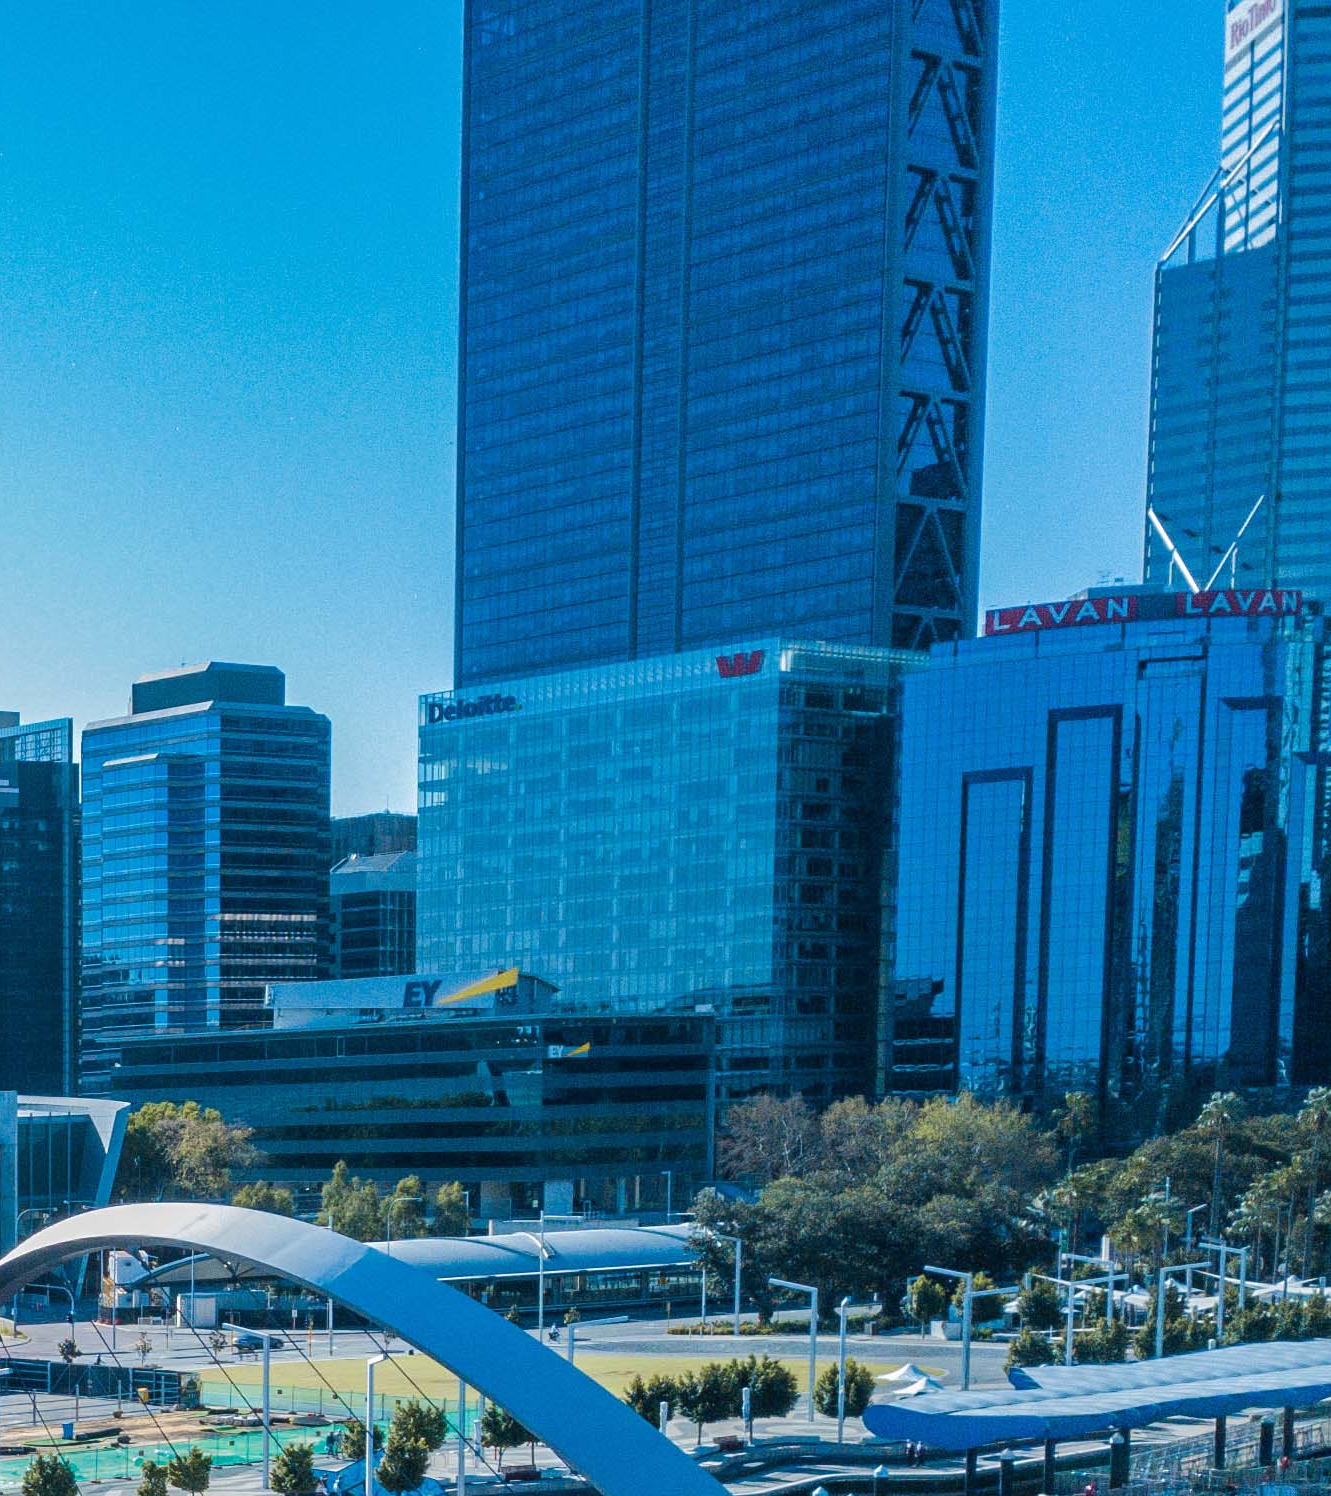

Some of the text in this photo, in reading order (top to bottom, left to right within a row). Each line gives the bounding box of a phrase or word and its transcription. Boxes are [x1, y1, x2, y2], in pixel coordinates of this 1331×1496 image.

[994, 598, 1129, 631] LAVAN
[1185, 591, 1298, 614] LAVAN
[403, 979, 443, 1007] EY
[550, 1046, 564, 1057] EY
